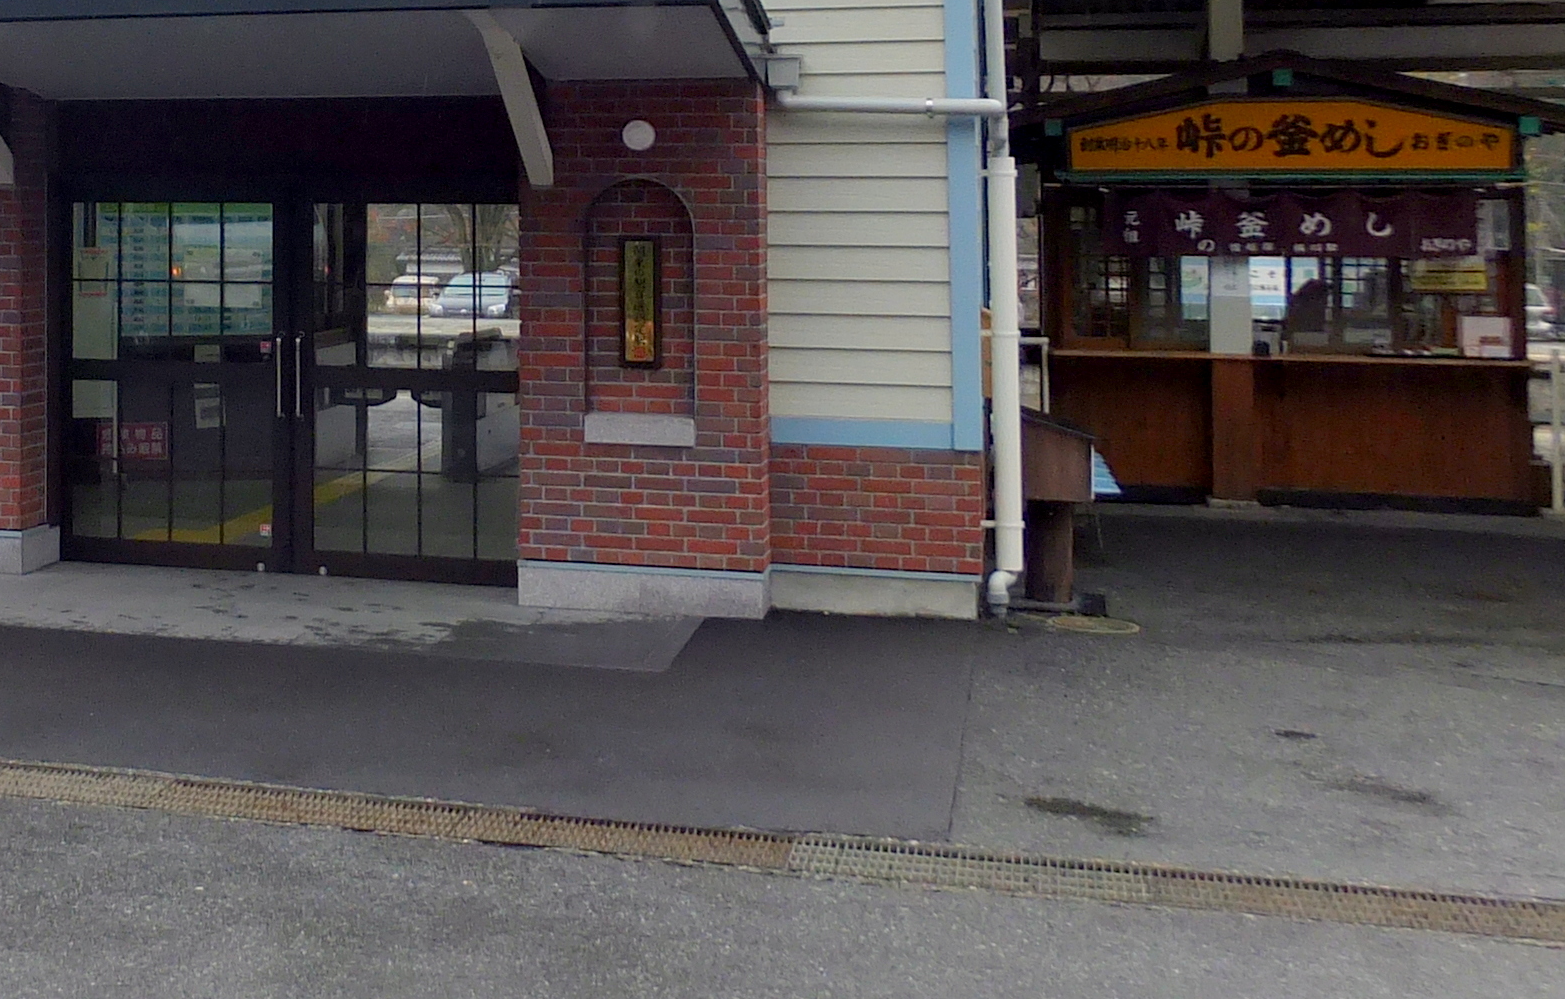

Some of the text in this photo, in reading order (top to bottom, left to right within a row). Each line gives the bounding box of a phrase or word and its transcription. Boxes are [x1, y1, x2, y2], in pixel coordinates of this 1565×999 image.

[1175, 113, 1405, 158] 峠の釜めし
[1412, 131, 1500, 151] おぎのや
